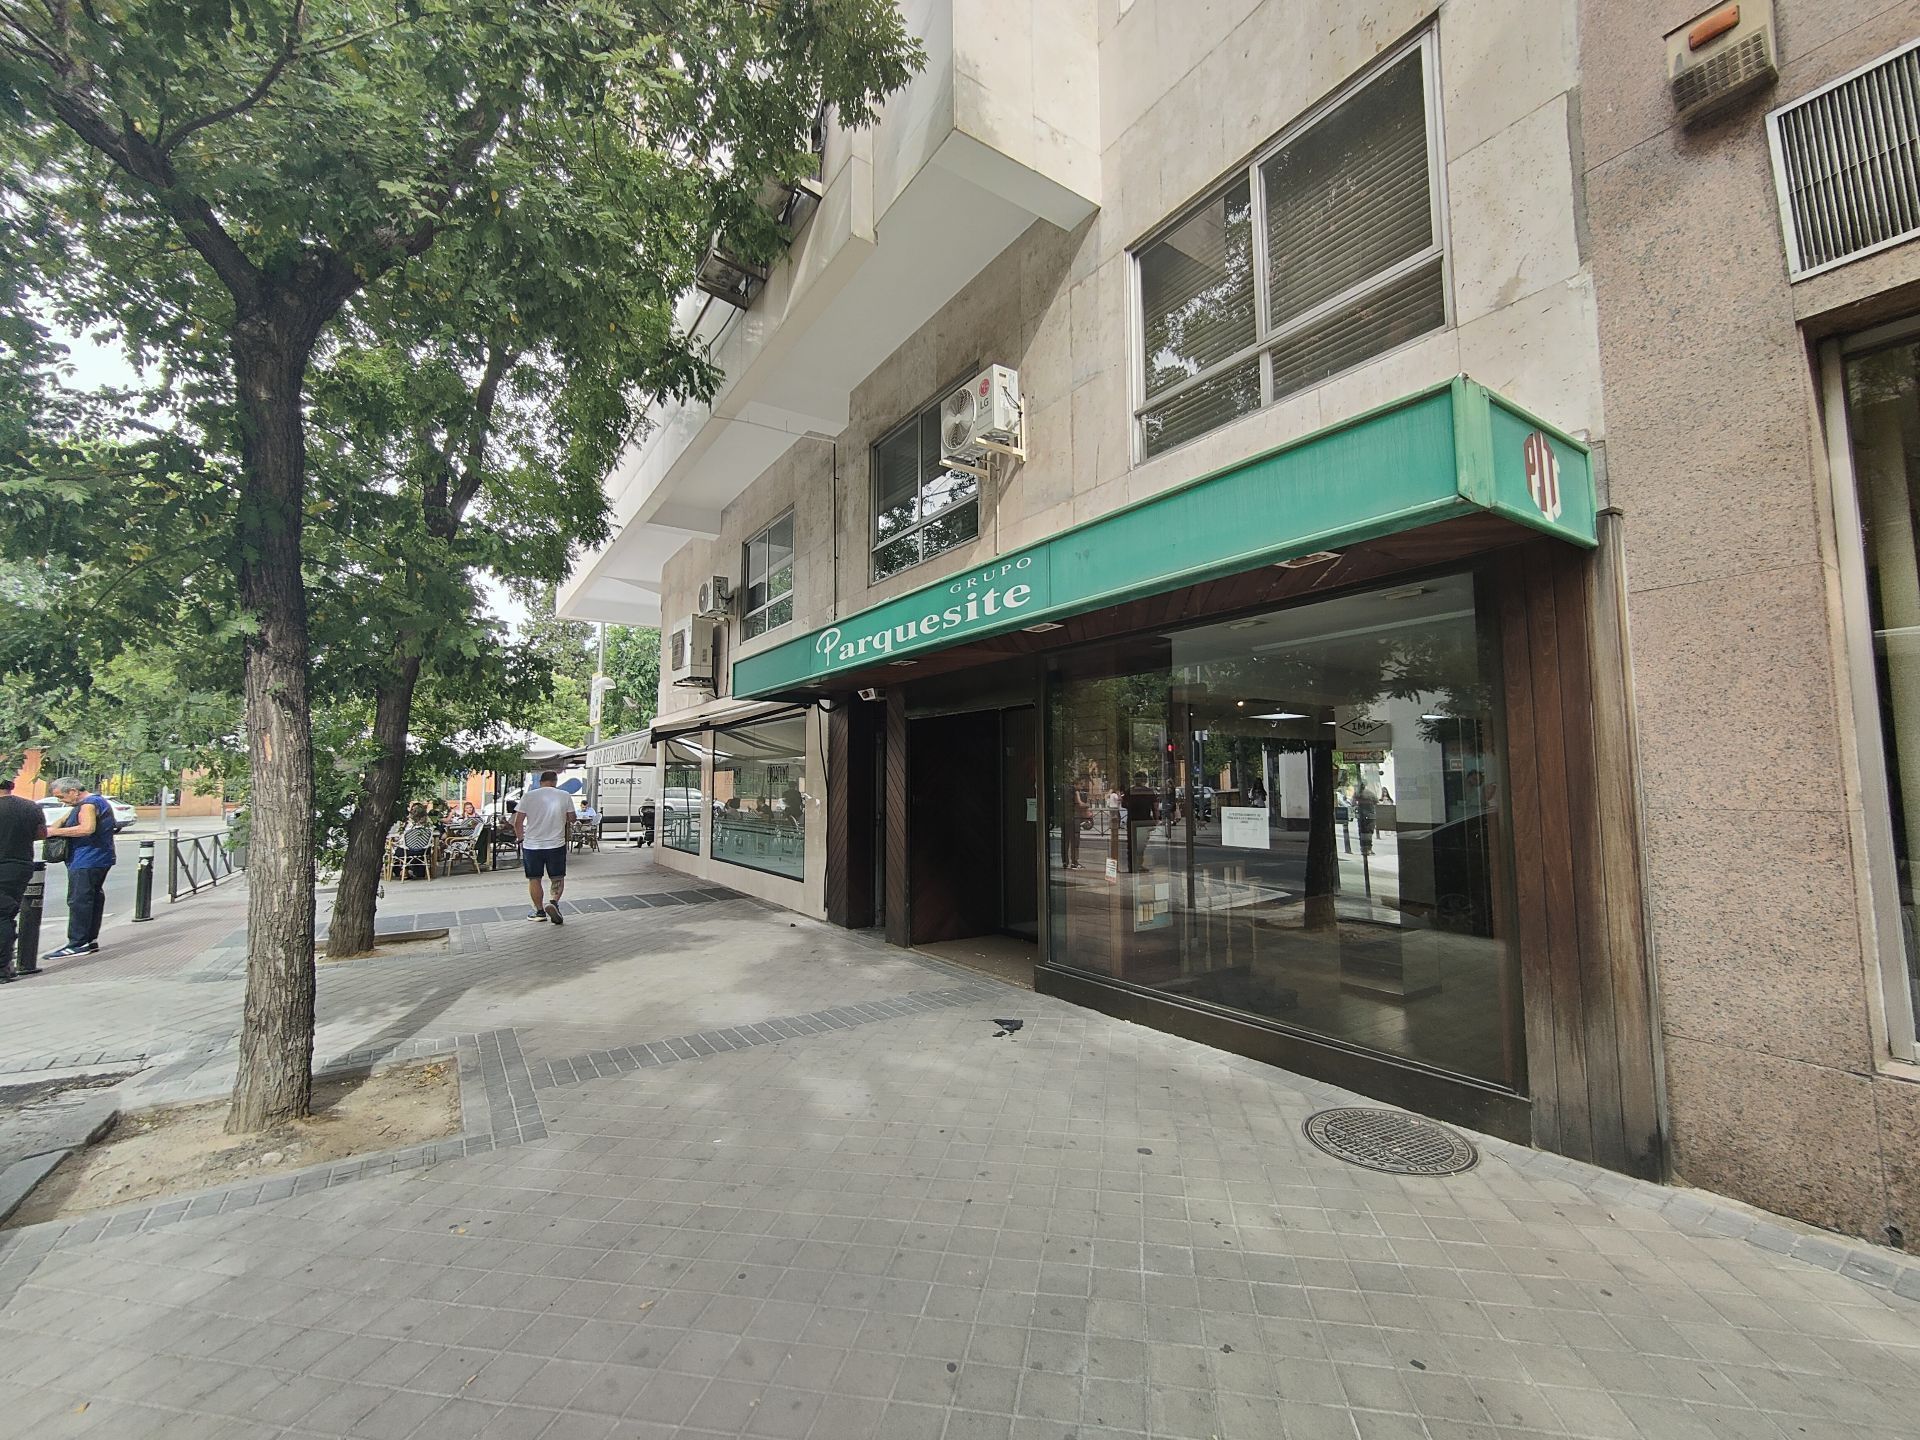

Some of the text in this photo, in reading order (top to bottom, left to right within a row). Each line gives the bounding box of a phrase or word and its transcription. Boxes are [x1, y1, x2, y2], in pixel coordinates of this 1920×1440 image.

[980, 398, 989, 409] LG
[949, 556, 1032, 594] GRUPO
[815, 584, 1031, 666] Parquesite
[1352, 722, 1373, 730] IMA
[603, 777, 642, 785] COFARES
